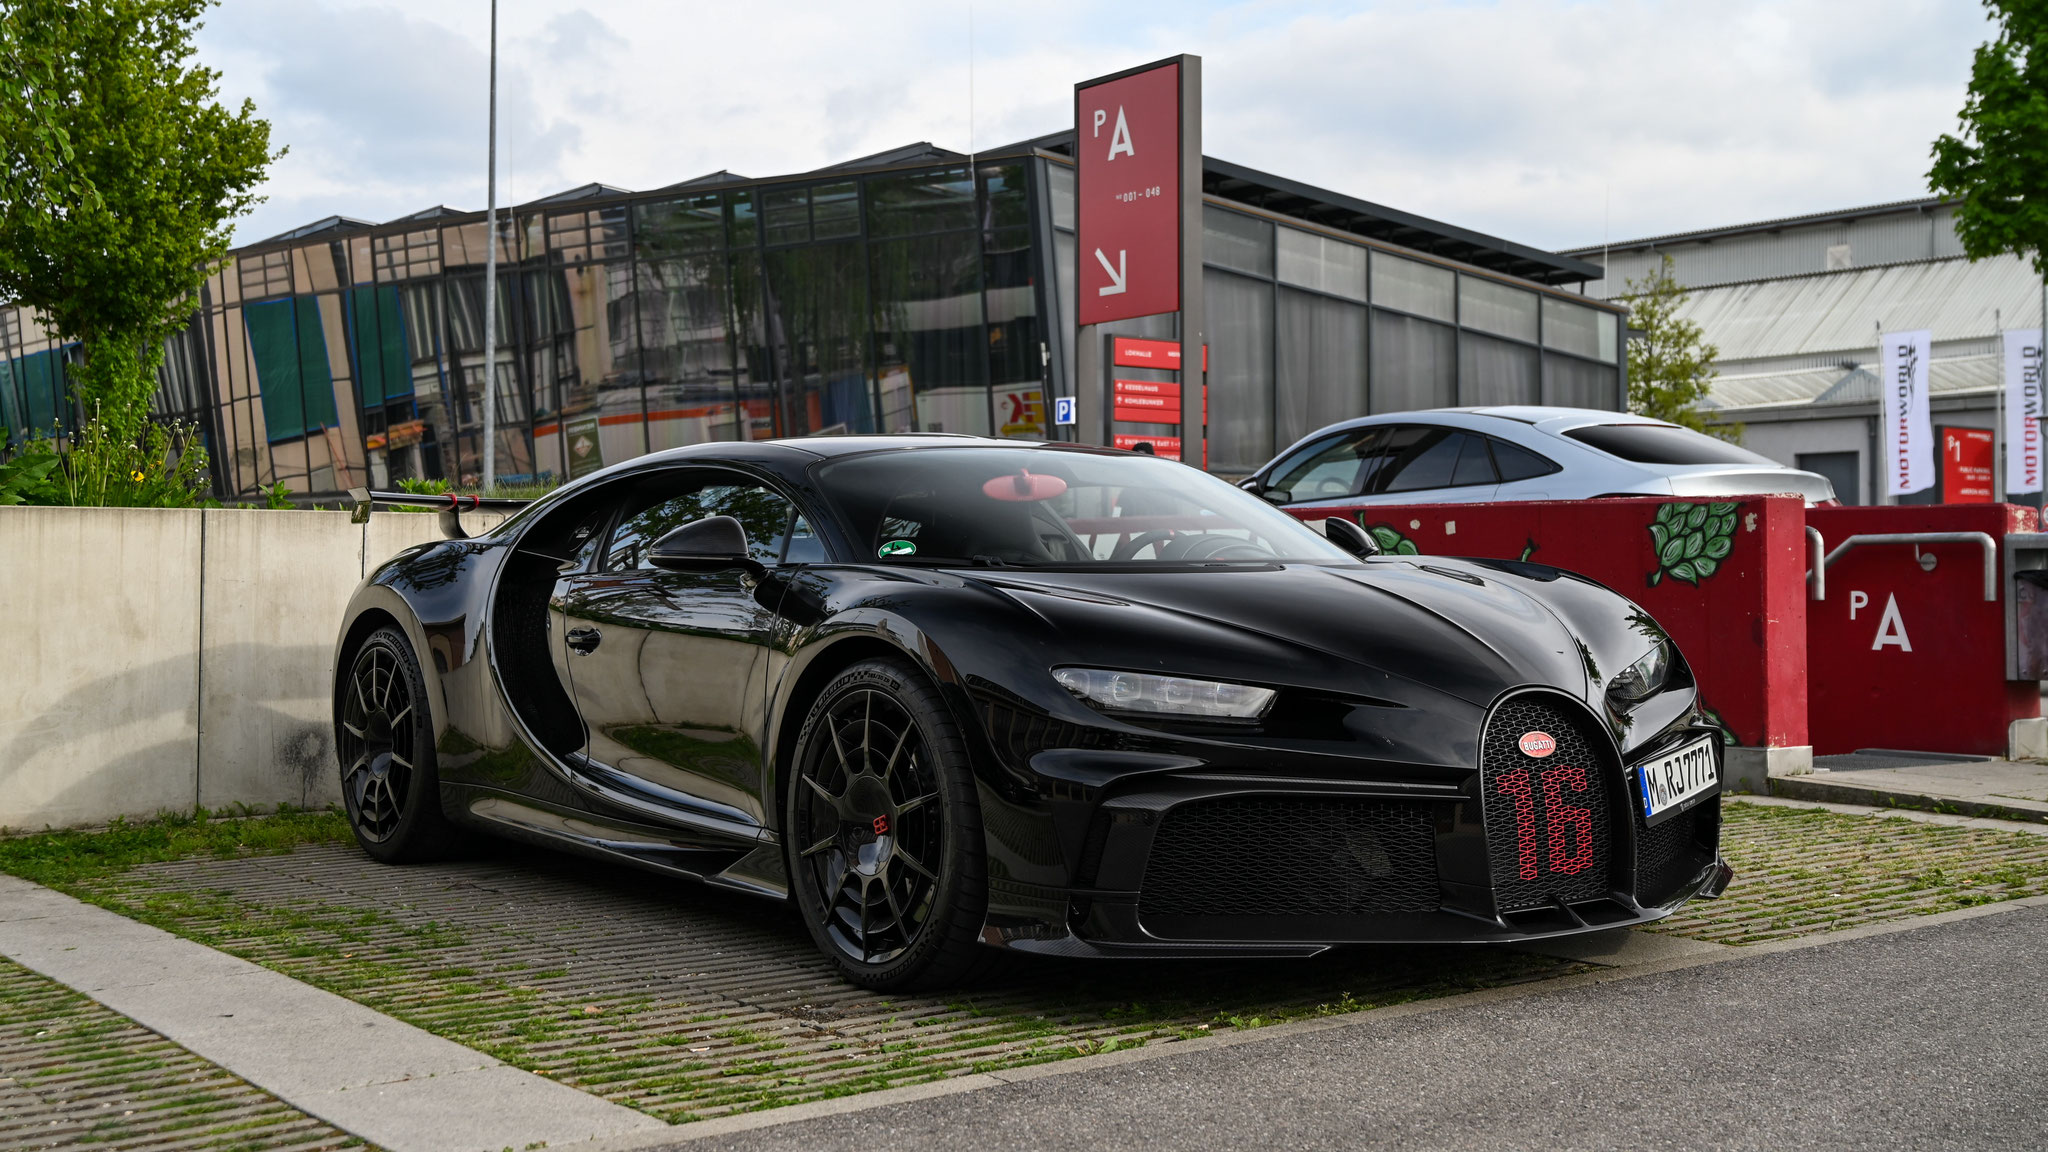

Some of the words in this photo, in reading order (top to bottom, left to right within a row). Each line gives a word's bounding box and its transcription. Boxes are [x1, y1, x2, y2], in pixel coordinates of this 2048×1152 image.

[1094, 109, 1106, 138] P
[1108, 104, 1134, 161] A
[1059, 402, 1069, 421] P
[1897, 344, 1910, 489] MOTORWORLD
[2023, 346, 2038, 486] MOTORWORLD
[1850, 590, 1869, 620] P
[1872, 591, 1912, 652] A
[1524, 740, 1553, 751] BUGATTI
[1646, 767, 1660, 808] M
[1496, 765, 1593, 880] 16
